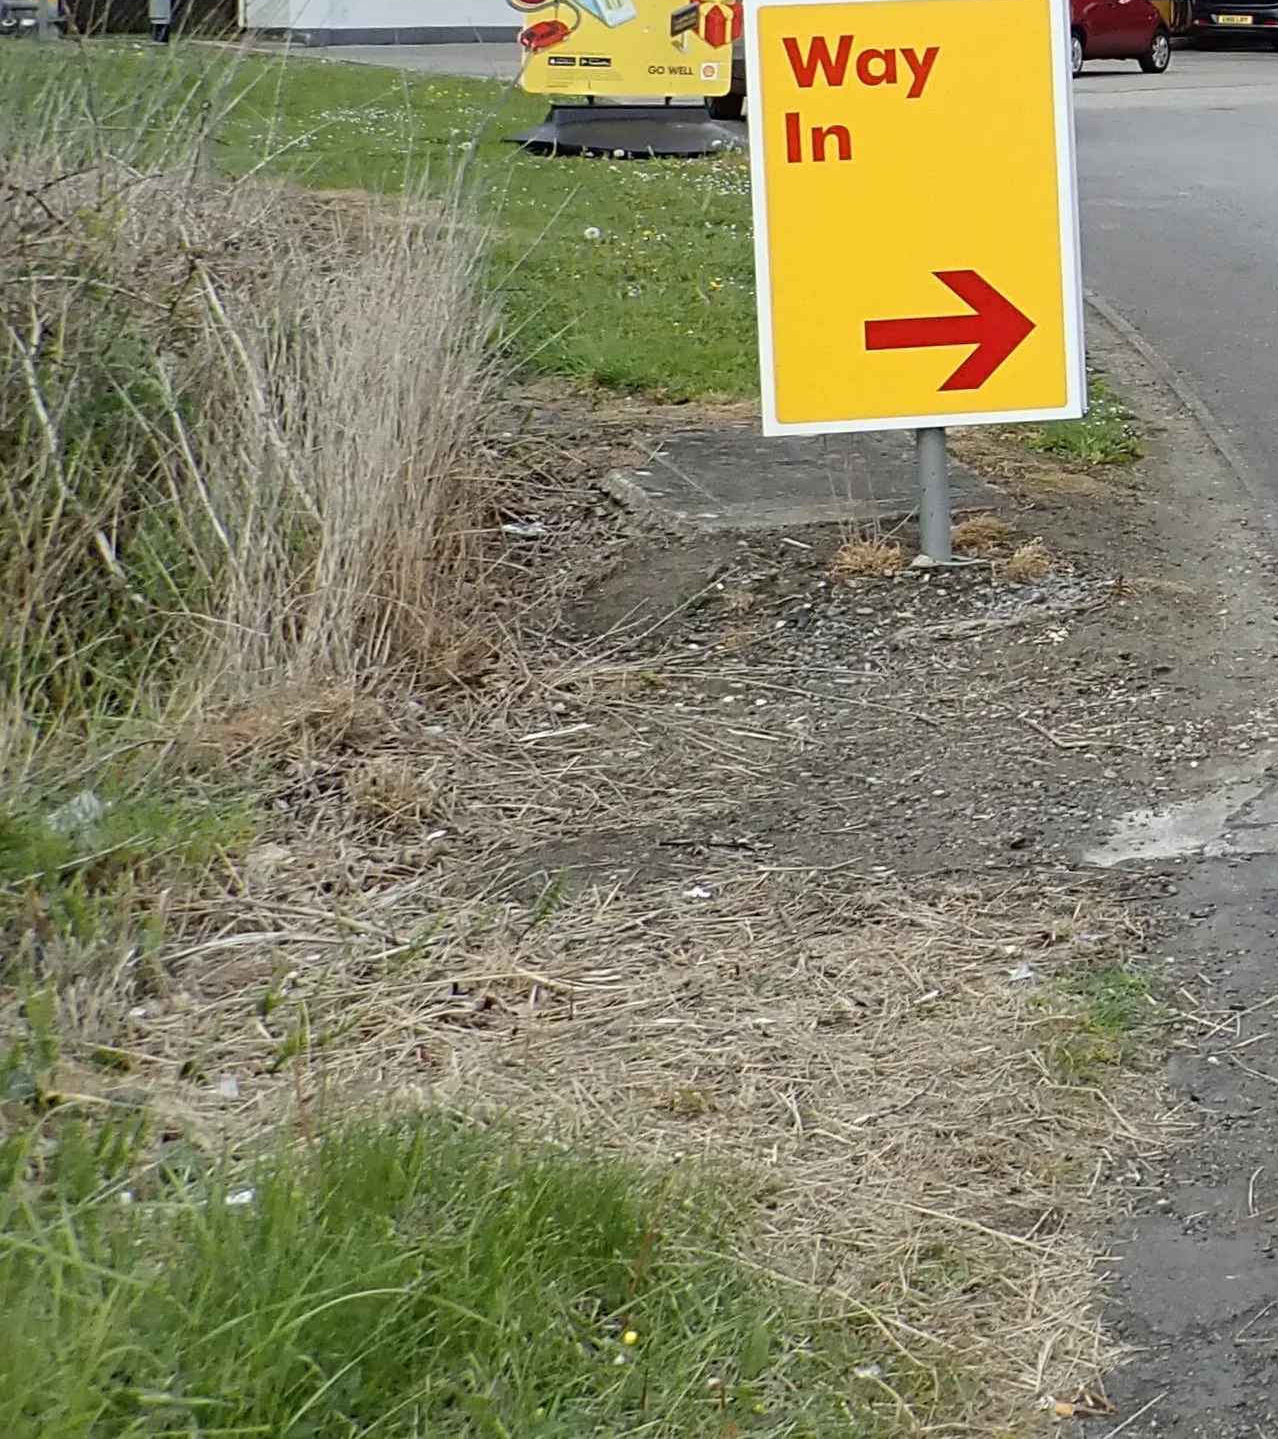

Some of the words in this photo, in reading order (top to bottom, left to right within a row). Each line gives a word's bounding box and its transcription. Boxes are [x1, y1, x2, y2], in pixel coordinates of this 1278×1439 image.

[648, 66, 664, 75] GO
[668, 67, 693, 75] WELL
[782, 35, 940, 98] Way
[785, 111, 852, 163] In
